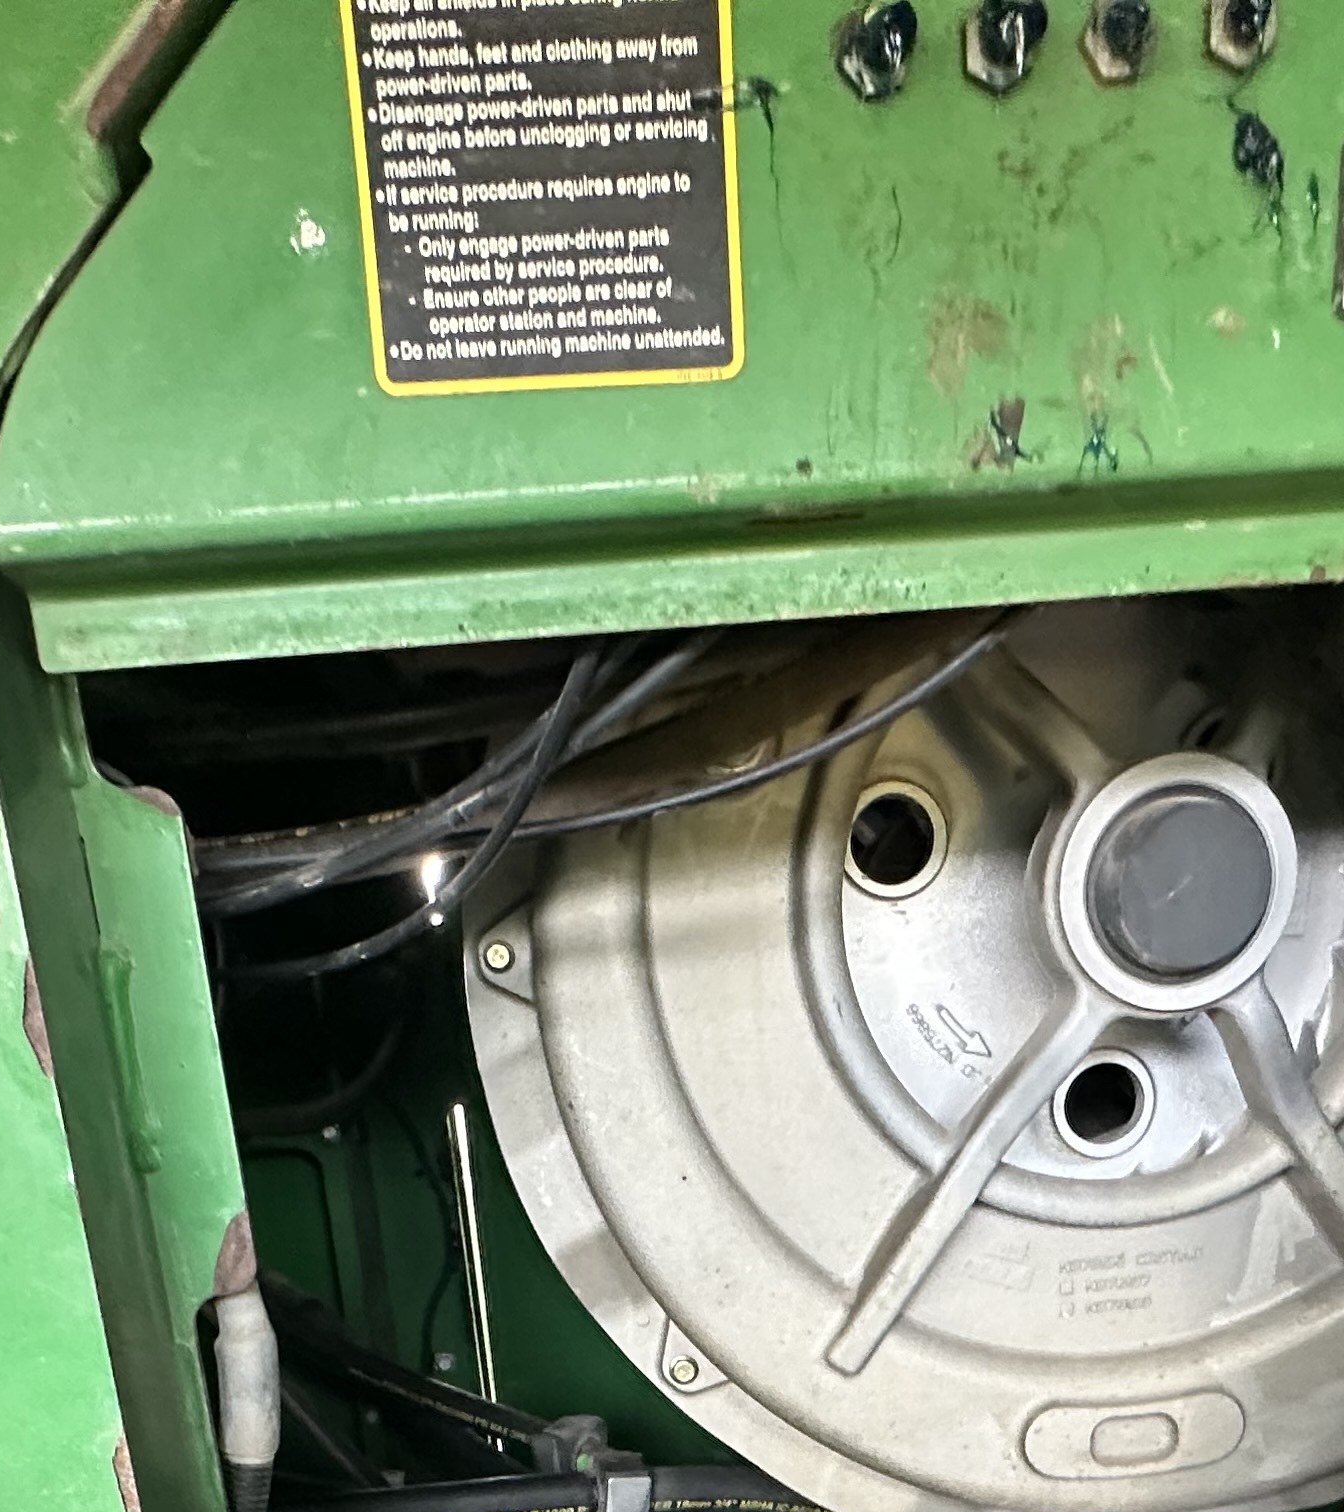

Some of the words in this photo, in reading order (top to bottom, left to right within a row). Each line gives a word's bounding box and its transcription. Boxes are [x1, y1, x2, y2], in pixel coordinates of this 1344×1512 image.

[370, 17, 462, 46] operations.
[373, 46, 415, 73] Keep
[418, 43, 474, 69] hands,
[476, 41, 507, 65] feet
[511, 39, 543, 63] and
[546, 37, 613, 64] clothing
[616, 38, 656, 62] away
[660, 33, 698, 58] from
[376, 72, 481, 101] power-driven
[485, 69, 532, 97] parts.
[378, 100, 464, 127] Disengage
[467, 94, 573, 125] power-driven
[576, 92, 618, 120] parts
[622, 89, 653, 113] and
[656, 87, 691, 112] shut
[381, 129, 404, 152] off
[407, 127, 461, 154] engine
[464, 125, 516, 149] before
[520, 120, 611, 148] unclogging
[614, 122, 632, 142] or
[635, 115, 708, 142] servicing
[384, 155, 456, 179] machine.
[386, 183, 397, 206] If
[400, 181, 458, 206] service
[462, 178, 544, 207] procedure
[547, 174, 613, 202] requires
[616, 171, 671, 199] engine
[674, 170, 691, 193] to
[388, 211, 409, 233] be
[419, 235, 456, 261] Only
[459, 234, 518, 259] engage
[521, 227, 624, 257] power-driven
[629, 225, 670, 252] parts
[424, 261, 491, 288] required
[494, 259, 514, 284] by
[518, 256, 575, 279] service
[579, 253, 664, 281] procedure.
[423, 287, 480, 310] Ensure
[482, 285, 525, 307] other
[528, 282, 582, 308] people
[585, 283, 610, 302] are
[614, 278, 653, 300] clear
[656, 275, 673, 298] of
[429, 312, 496, 338] operator
[499, 310, 554, 332] station
[557, 307, 587, 329] and
[590, 304, 662, 327] machine.
[400, 340, 423, 361] Do
[426, 339, 453, 360] not
[455, 337, 497, 358] leave
[500, 334, 562, 358] running
[565, 331, 632, 353] machine
[635, 323, 725, 350] unattended.
